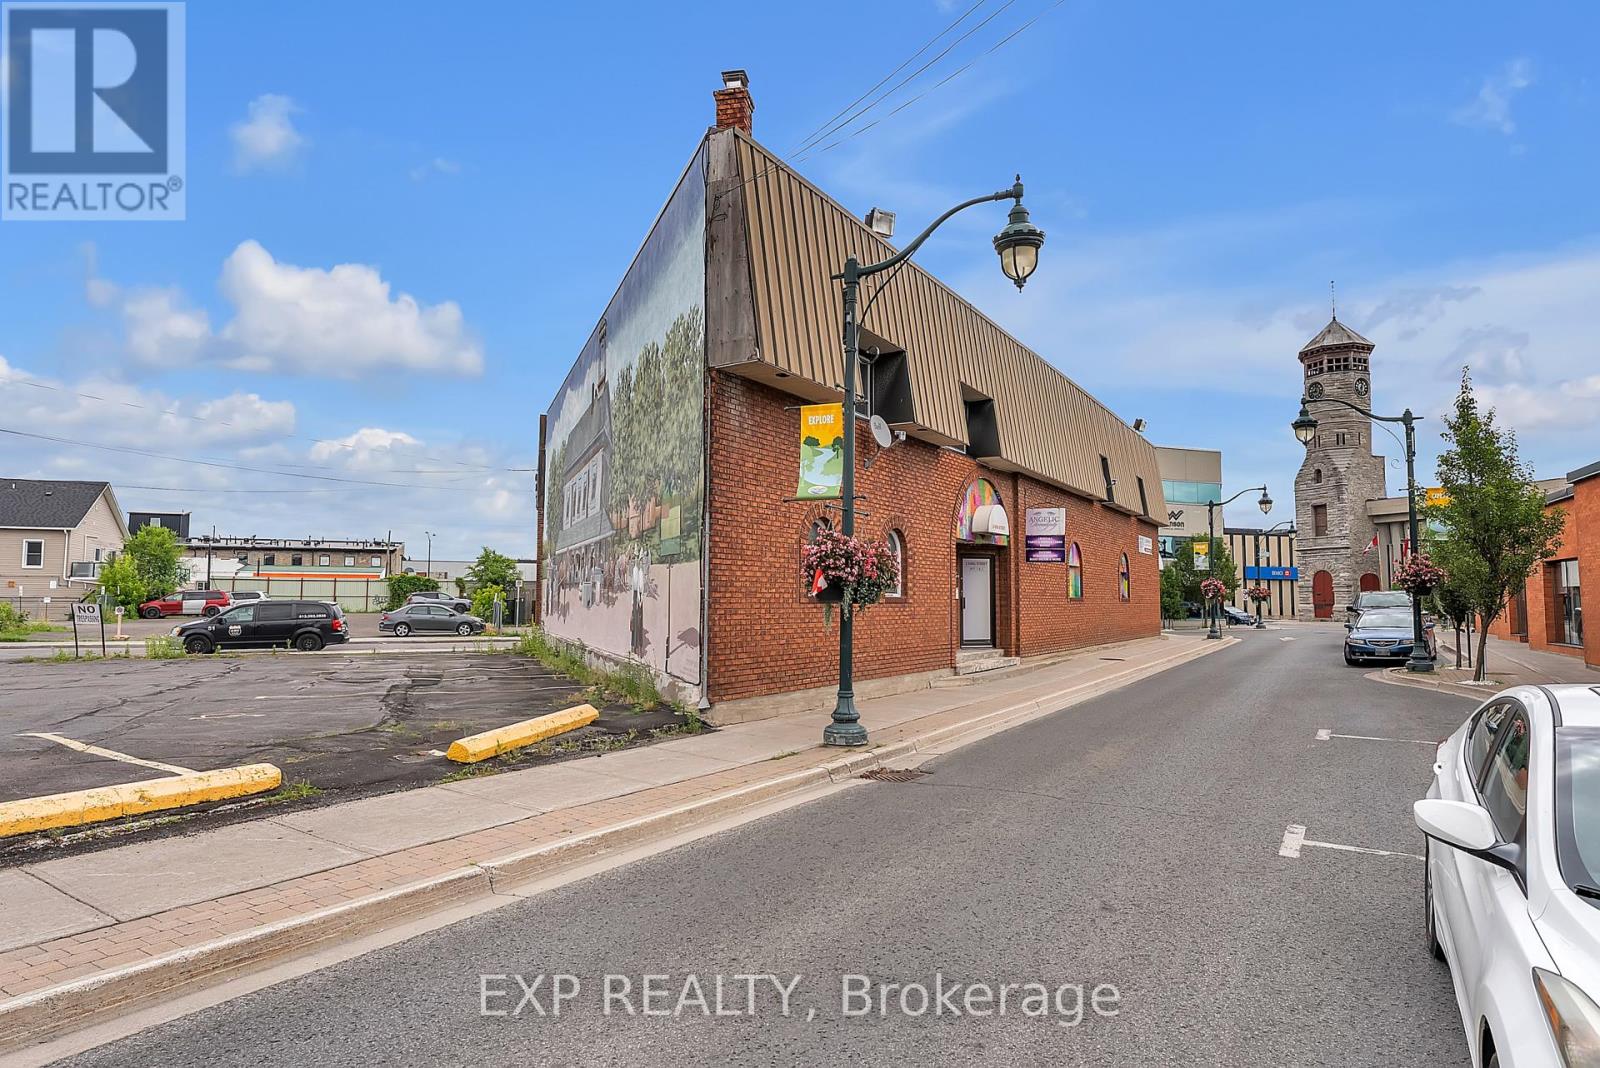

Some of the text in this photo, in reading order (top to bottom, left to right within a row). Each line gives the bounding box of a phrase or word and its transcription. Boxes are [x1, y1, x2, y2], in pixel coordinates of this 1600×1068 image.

[808, 414, 835, 425] EXPLORE
[1029, 515, 1060, 523] ANGELIC
[77, 605, 96, 614] NO
